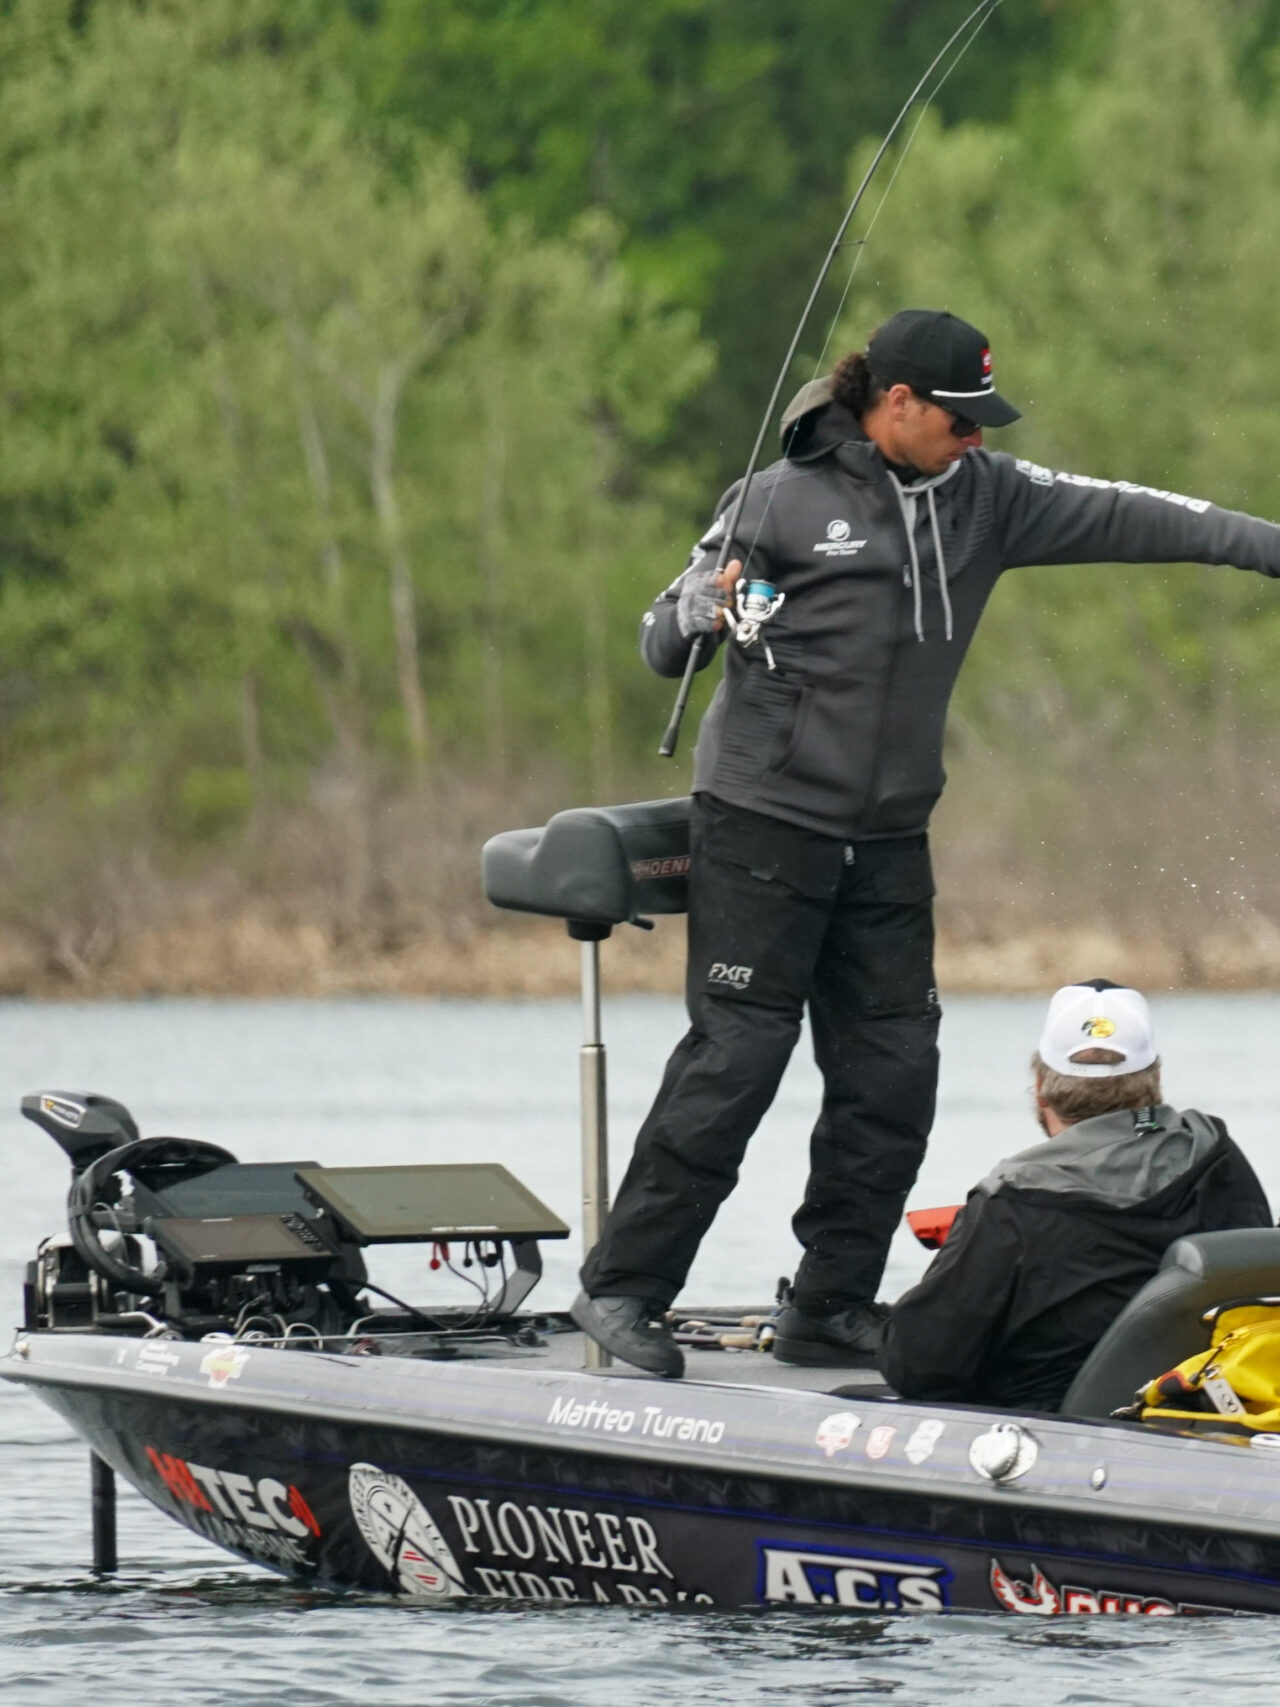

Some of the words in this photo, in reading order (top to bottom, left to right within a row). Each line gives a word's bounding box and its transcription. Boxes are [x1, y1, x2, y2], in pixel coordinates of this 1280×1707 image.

[812, 540, 868, 552] MERCURY
[708, 962, 753, 983] FXR
[547, 1396, 635, 1433] Matteo
[641, 1406, 725, 1444] Turano
[447, 1495, 674, 1579] PIONEER
